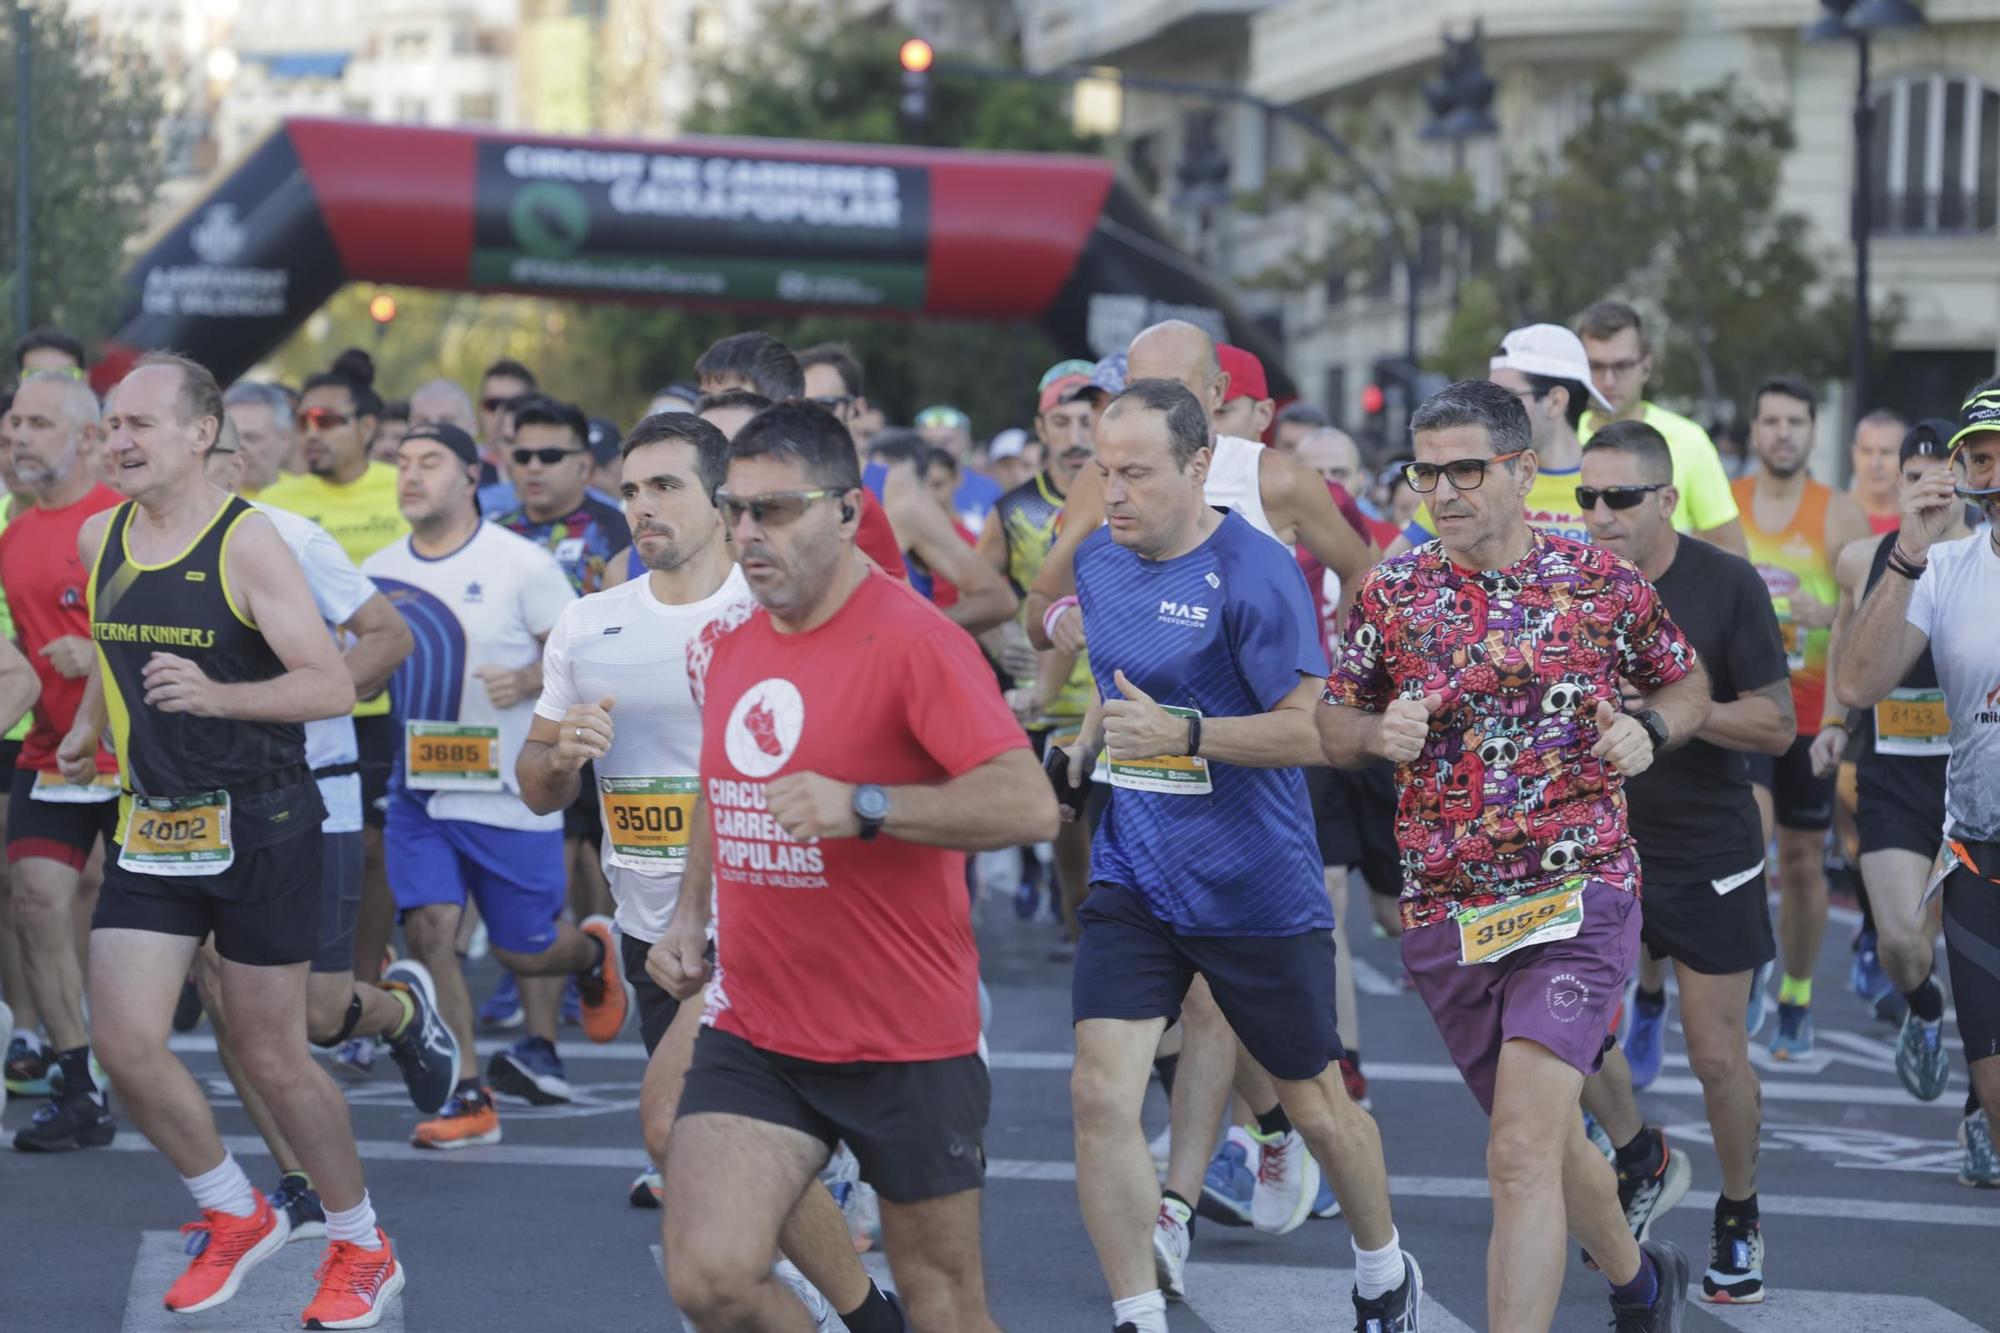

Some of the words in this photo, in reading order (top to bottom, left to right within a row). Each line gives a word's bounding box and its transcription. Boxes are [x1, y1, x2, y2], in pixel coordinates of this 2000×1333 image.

[505, 145, 645, 181] CIRCUIT
[646, 155, 699, 181] DE
[702, 157, 898, 192] CARRERES
[1159, 600, 1209, 621] MAS
[140, 624, 215, 648] RUNNERS
[419, 743, 480, 763] 3685
[708, 778, 769, 810] CIRCU
[138, 817, 208, 841] 4002
[613, 805, 683, 832] 3500
[718, 837, 825, 874] POPULARS
